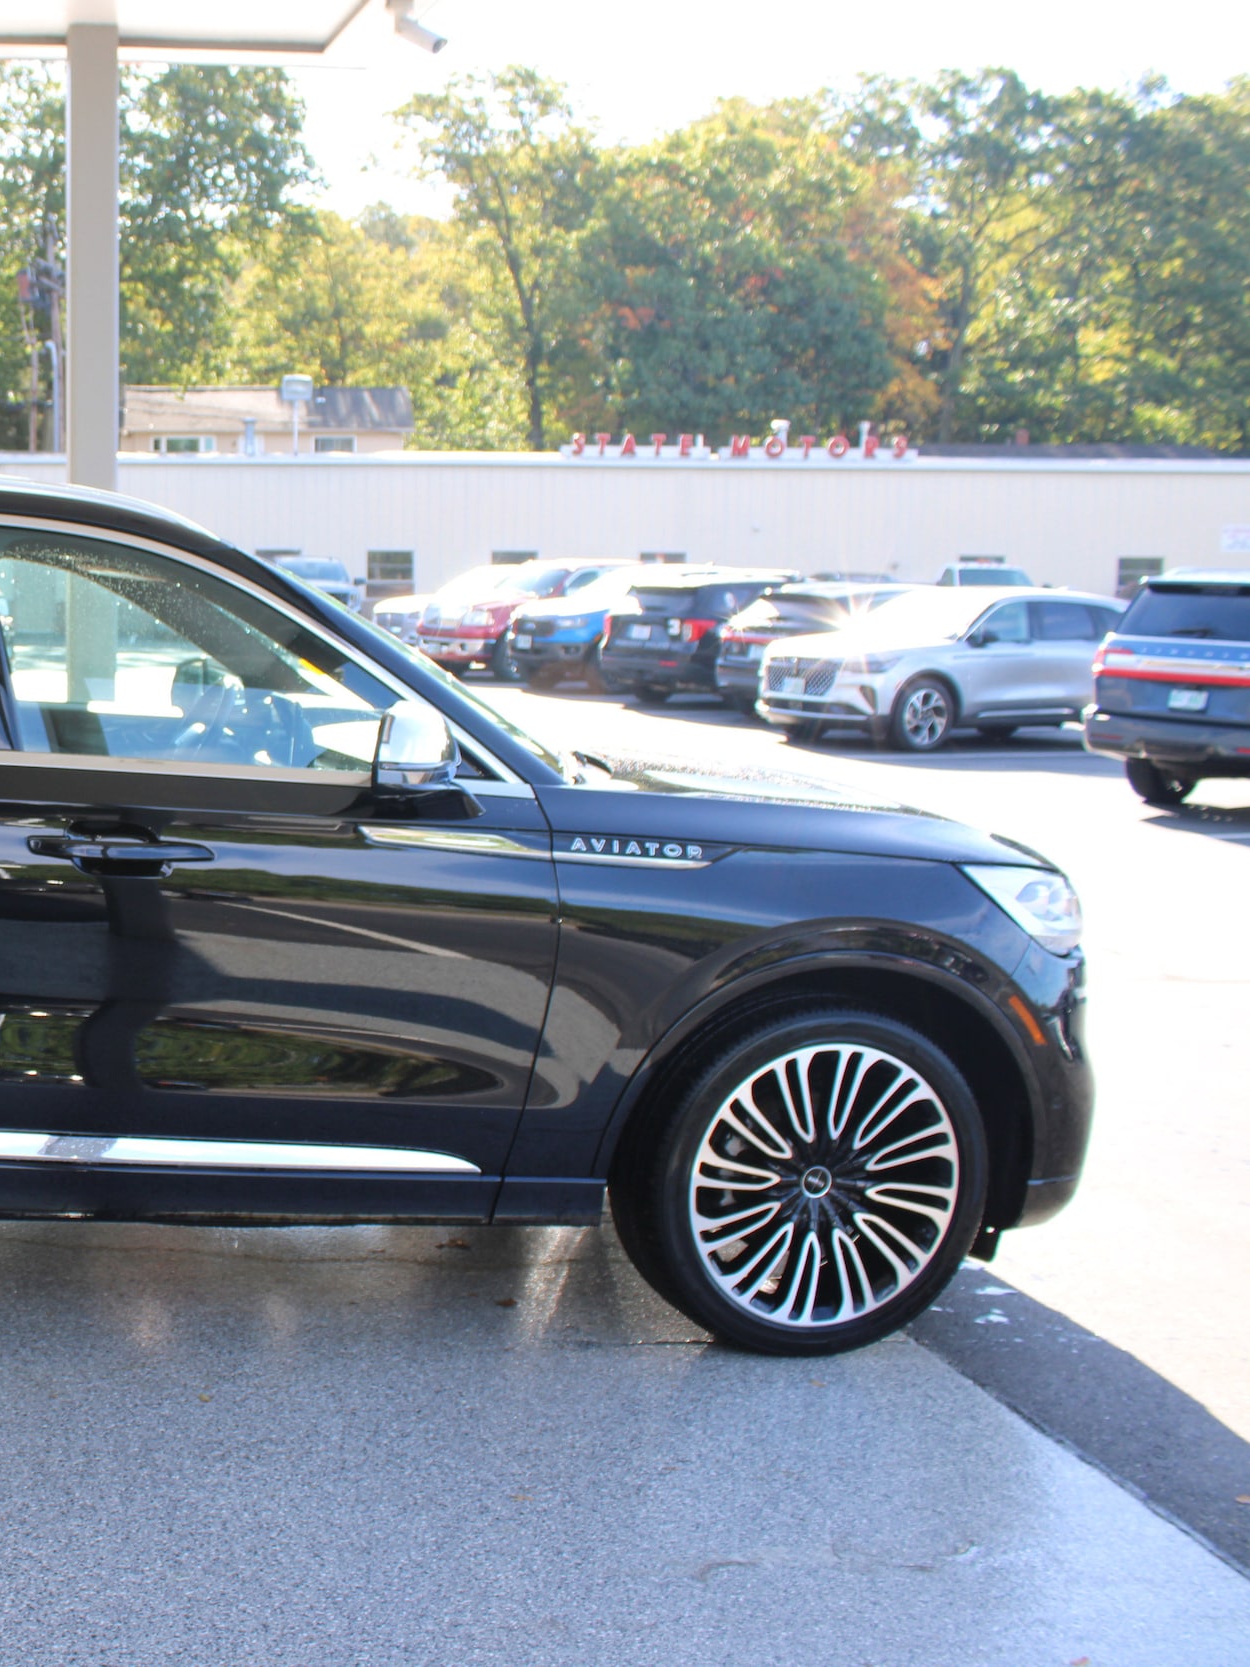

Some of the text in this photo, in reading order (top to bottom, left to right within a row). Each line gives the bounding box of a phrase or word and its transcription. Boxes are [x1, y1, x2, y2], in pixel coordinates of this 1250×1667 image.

[572, 432, 908, 459] STATE MOTORS
[570, 837, 703, 859] AVIATOR
